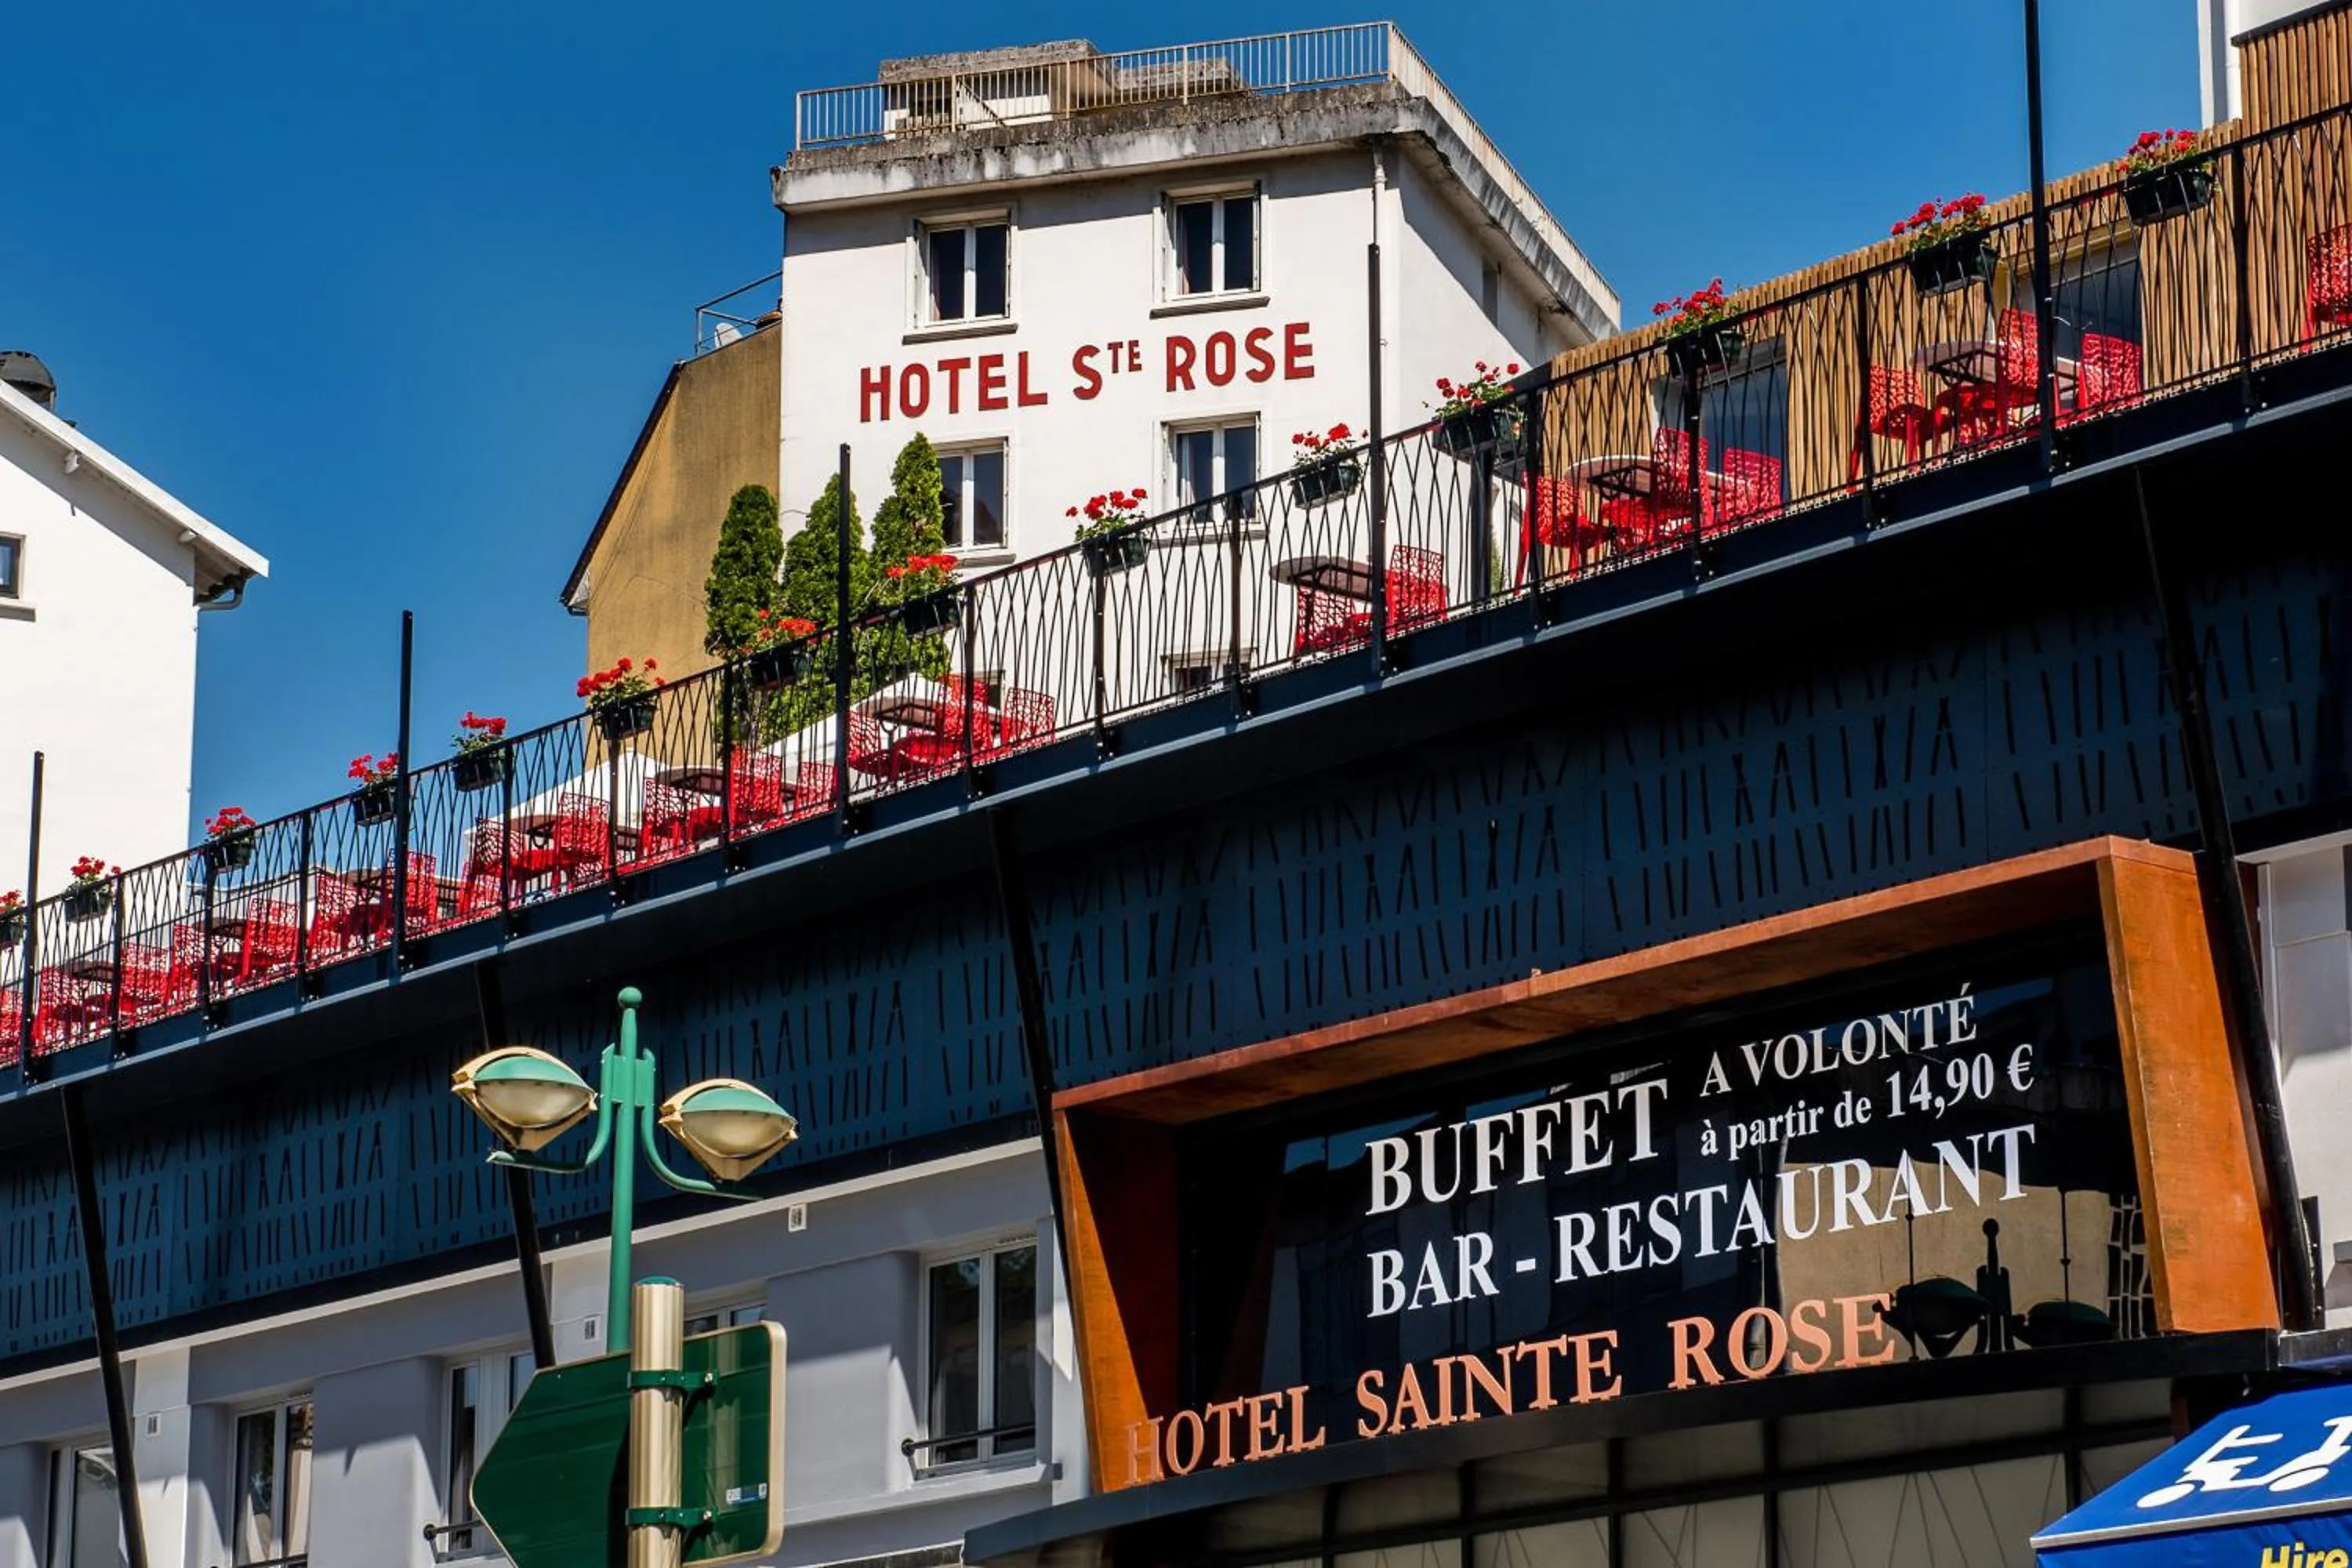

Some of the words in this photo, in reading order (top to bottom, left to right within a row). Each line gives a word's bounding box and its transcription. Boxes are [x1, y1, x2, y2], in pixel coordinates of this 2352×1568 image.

[860, 350, 1048, 423] HOTEL
[1165, 321, 1315, 393] ROSE
[1365, 1078, 1668, 1216] BUFFET
[1699, 1051, 1733, 1097] A
[1740, 982, 1977, 1086] VOLONTÉ
[1700, 1119, 1719, 1157] à
[1728, 1100, 1825, 1160] partir
[1833, 1090, 1873, 1129] de
[1885, 1052, 1994, 1120] 14,90
[2006, 1044, 2035, 1092] €
[1367, 1230, 1500, 1318] BAR
[1553, 1123, 2036, 1283] RESTAURANT
[1124, 1385, 1327, 1486] HOTEL
[1356, 1329, 1624, 1439] SAINTE
[1667, 1292, 1896, 1391] ROSE
